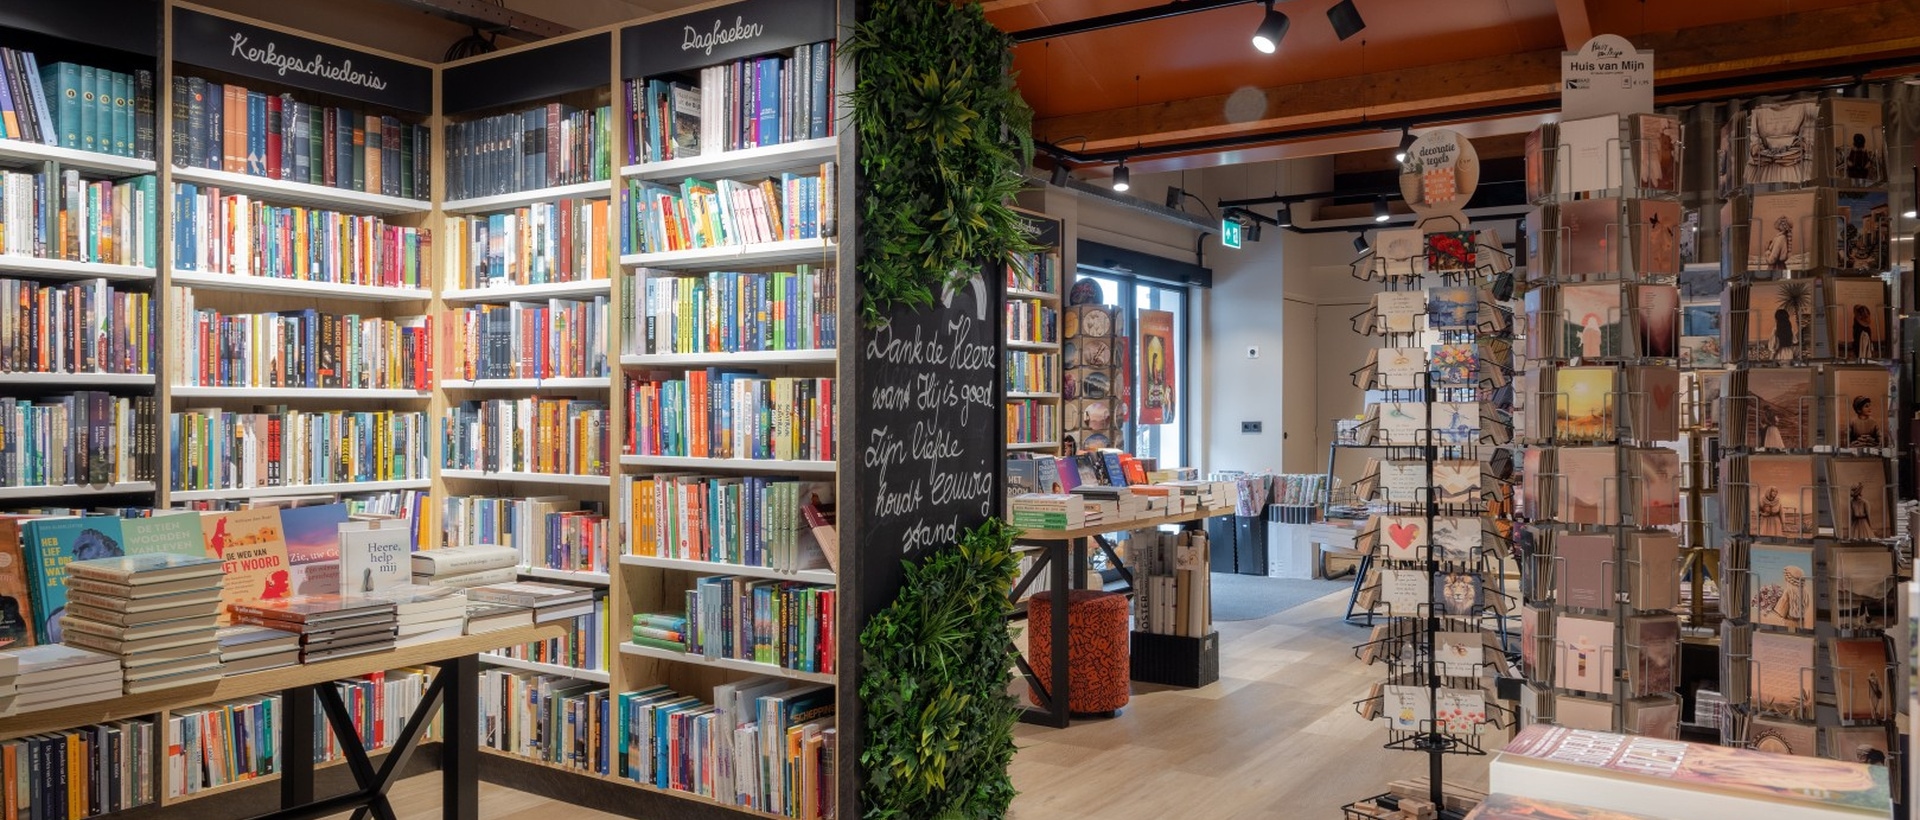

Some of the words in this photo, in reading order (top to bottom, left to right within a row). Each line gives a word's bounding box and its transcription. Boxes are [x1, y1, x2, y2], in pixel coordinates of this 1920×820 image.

[681, 15, 764, 56] Dagboeken
[230, 32, 388, 92] Kerkgeschiedenis
[1570, 62, 1595, 71] Huis
[1598, 63, 1618, 71] van
[1621, 61, 1645, 72] Mijn
[1419, 143, 1456, 157] decoratie
[1425, 153, 1450, 168] tegels
[866, 316, 924, 365] Dank
[925, 330, 948, 365] de
[948, 314, 996, 370] Heere
[872, 379, 912, 412] want
[917, 372, 941, 436] Hij
[943, 379, 958, 406] is
[961, 380, 995, 427] goed.
[865, 425, 907, 487] Zijn
[912, 421, 964, 486] liefde
[1008, 475, 1022, 484] HET
[875, 479, 923, 518] houdt
[137, 524, 152, 534] DE
[154, 521, 180, 532] TIEN
[902, 515, 958, 553] stand
[41, 537, 58, 547] HEB
[130, 531, 190, 545] WOORDEN
[43, 547, 61, 556] LIEF
[131, 545, 154, 554] VAN
[156, 540, 192, 552] LEVEN
[368, 542, 402, 553] Heere,
[44, 557, 56, 567] EN
[58, 556, 73, 566] DOE
[226, 552, 236, 561] DE
[237, 550, 253, 559] WEG
[253, 548, 267, 557] VAN
[289, 552, 309, 563] Zie,
[310, 551, 324, 560] uw
[326, 548, 339, 558] Go
[370, 552, 394, 565] help
[241, 555, 280, 571] WOORD
[380, 562, 397, 575] mij
[46, 567, 65, 577] WAT
[47, 577, 58, 587] JE
[1141, 595, 1149, 635] OSTER
